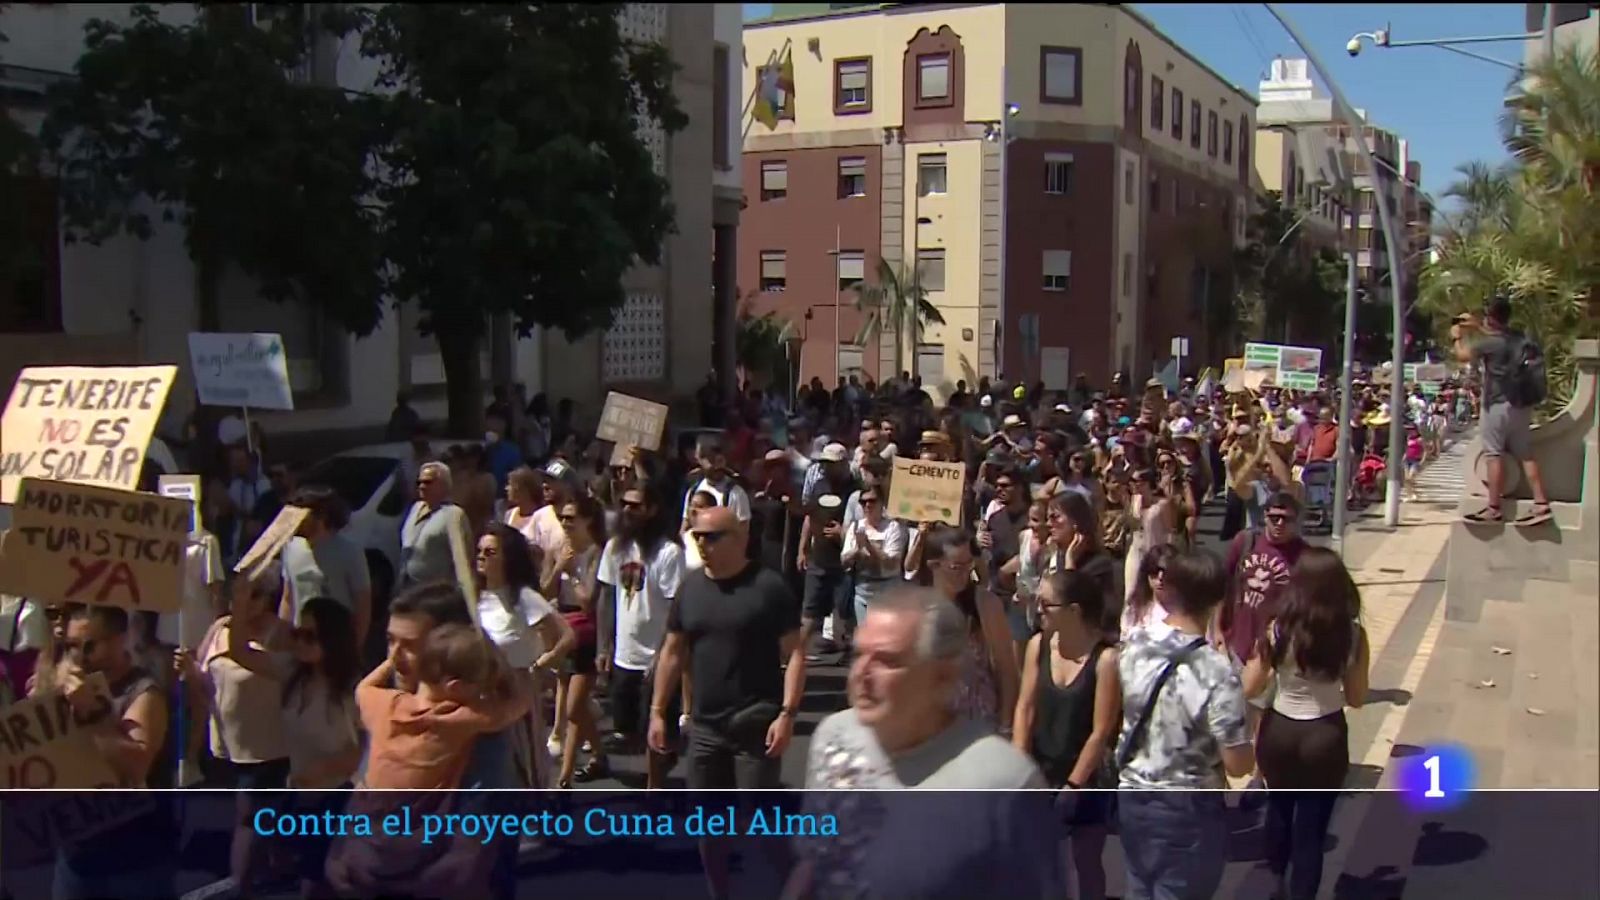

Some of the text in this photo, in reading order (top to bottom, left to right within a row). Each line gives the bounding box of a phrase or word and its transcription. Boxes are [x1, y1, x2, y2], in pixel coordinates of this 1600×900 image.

[19, 378, 162, 411] TENERIFE
[39, 417, 131, 446] NO ES
[39, 447, 140, 486] SOLAR
[19, 527, 181, 566] TURISTICA
[65, 557, 141, 605] YA
